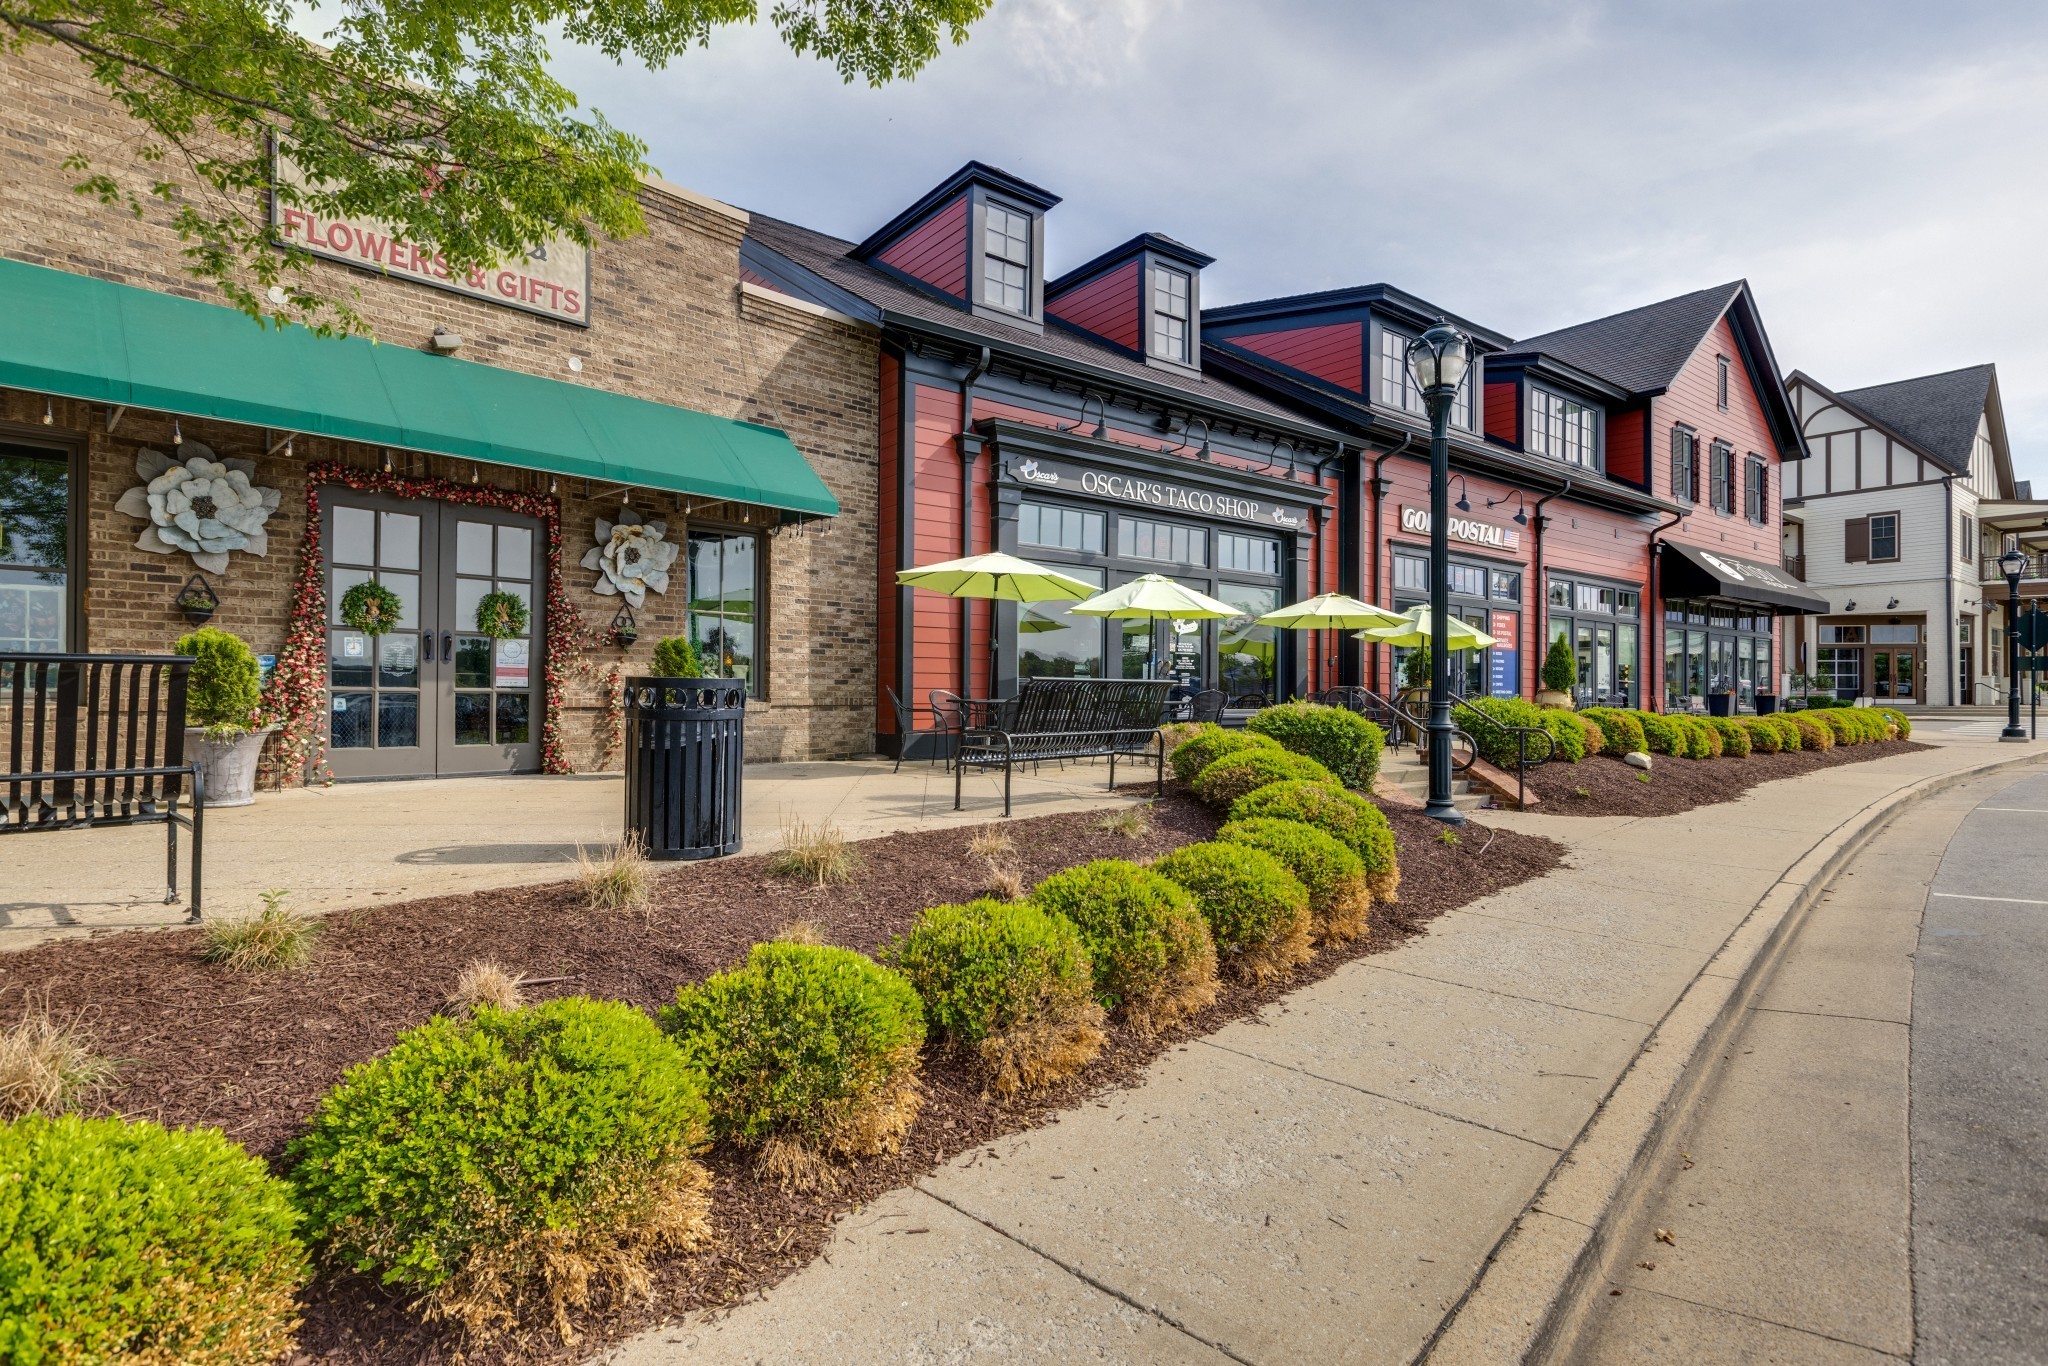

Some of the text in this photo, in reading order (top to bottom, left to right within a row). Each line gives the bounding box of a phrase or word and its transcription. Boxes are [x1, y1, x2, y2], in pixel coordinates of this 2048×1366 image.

[284, 208, 452, 280] FLOWERS
[465, 260, 486, 289] &
[498, 271, 581, 314] GIFTS
[1081, 471, 1259, 520] OSCAR'S TACO SHOP
[1447, 517, 1503, 546] POSTAL
